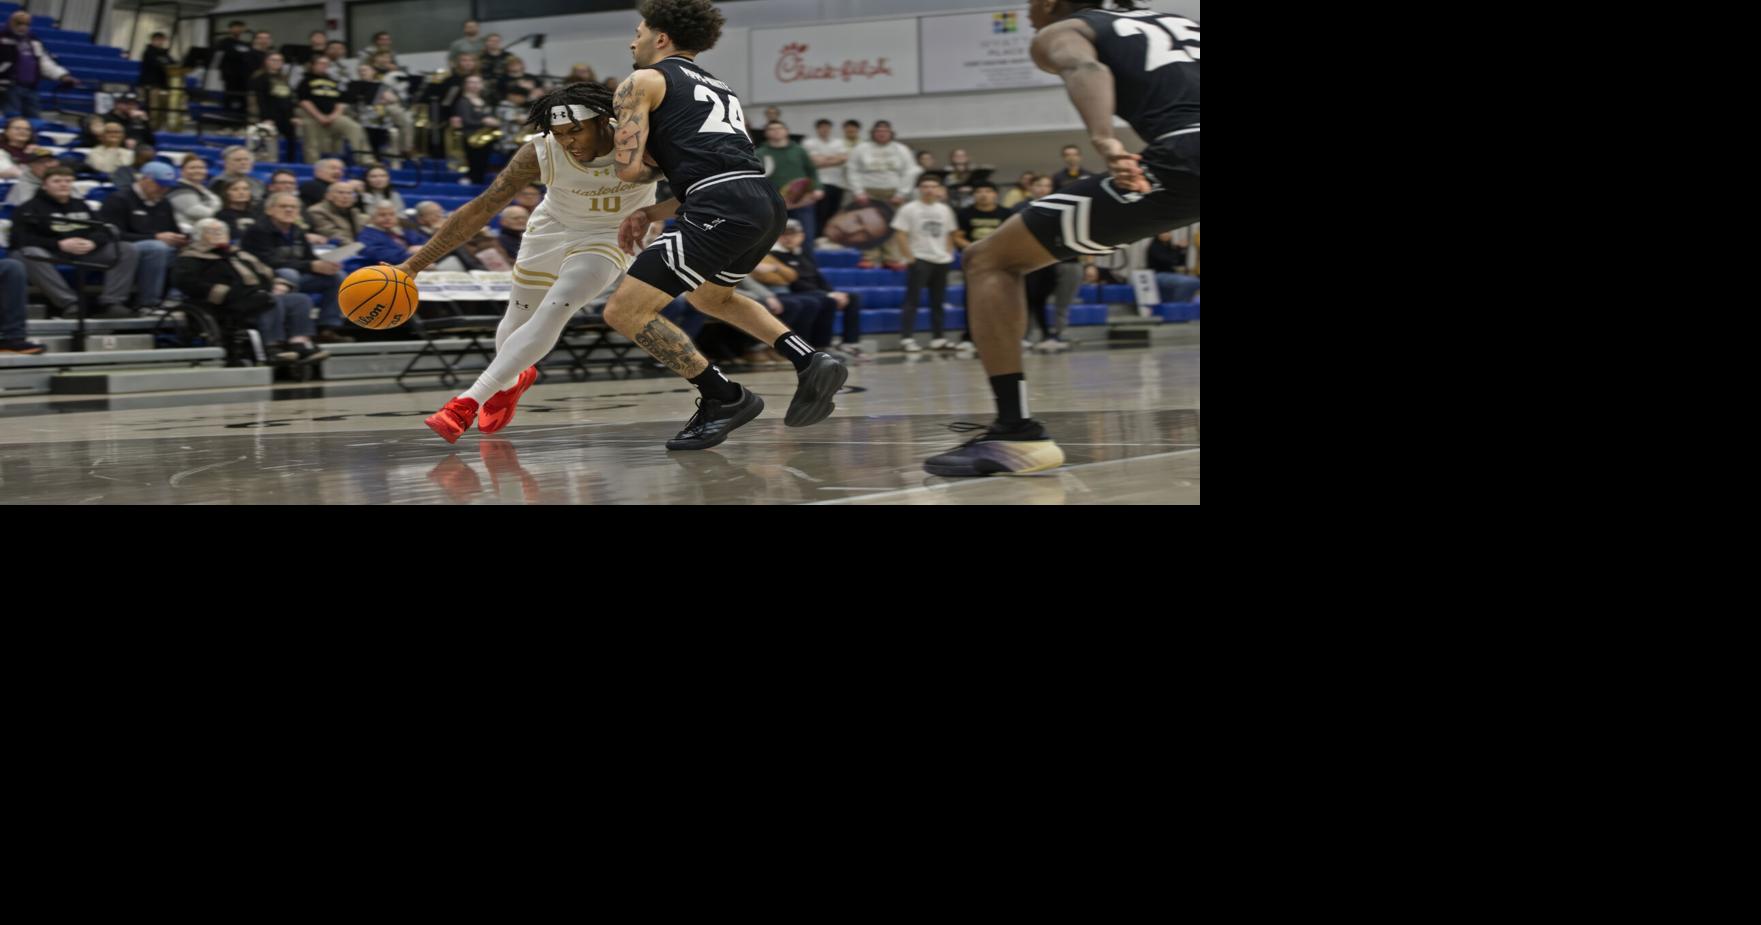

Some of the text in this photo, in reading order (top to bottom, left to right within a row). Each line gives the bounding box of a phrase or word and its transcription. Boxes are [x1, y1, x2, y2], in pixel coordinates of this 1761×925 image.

[1112, 16, 1200, 72] 25
[693, 84, 753, 143] 24
[571, 181, 642, 197] astodon
[589, 196, 621, 213] 10
